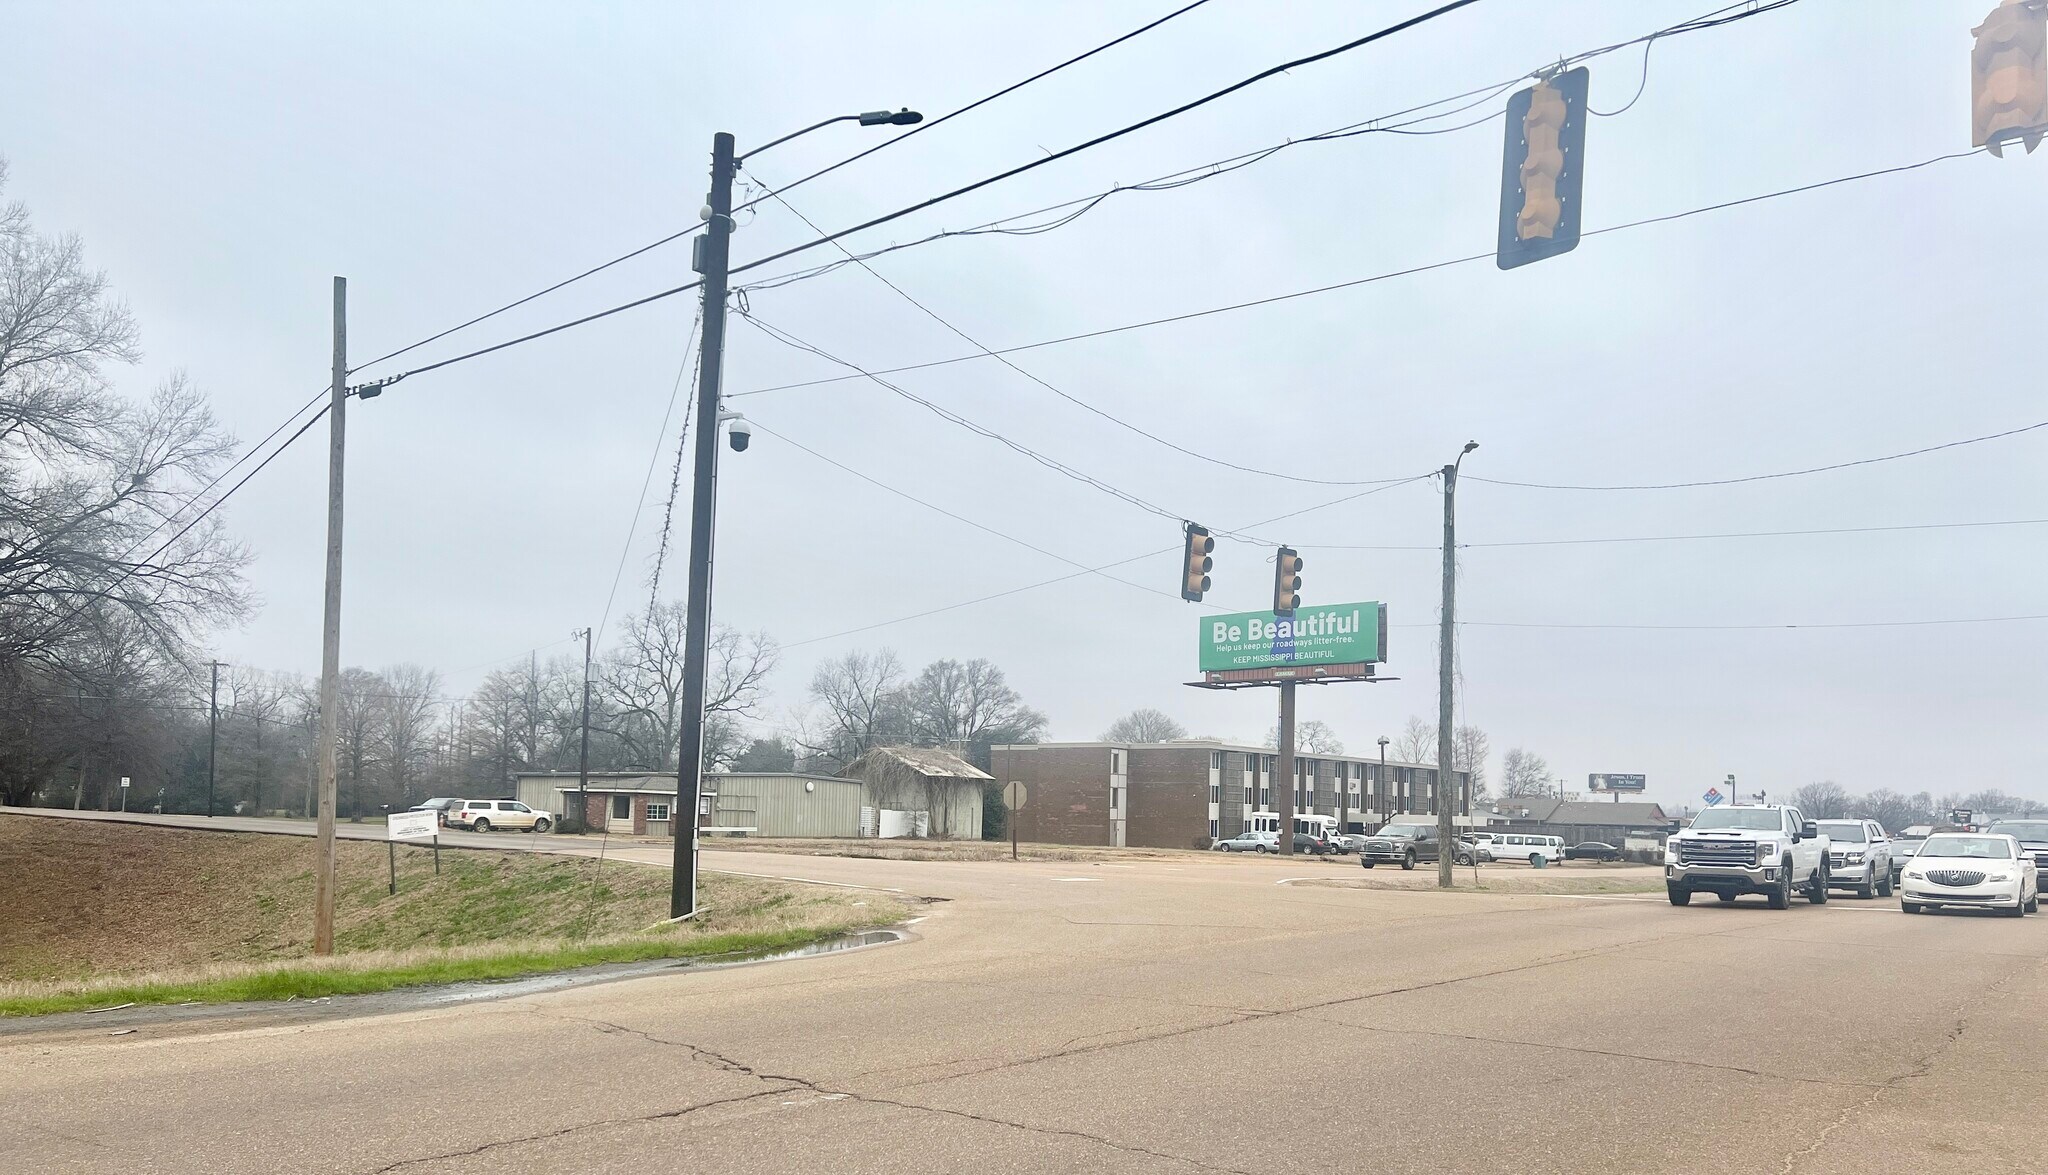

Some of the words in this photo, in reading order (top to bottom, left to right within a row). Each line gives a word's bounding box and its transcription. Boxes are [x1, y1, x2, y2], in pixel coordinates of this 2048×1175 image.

[1213, 622, 1241, 643] Be
[1248, 610, 1359, 640] Beautiful
[1216, 644, 1232, 653] Help
[1243, 643, 1261, 651] keep
[1262, 641, 1274, 649] our
[1276, 639, 1313, 648] roadways
[1314, 636, 1355, 645] litter-free.
[1233, 655, 1252, 664] KEEP
[1252, 652, 1293, 663] MISSISSIPPI
[1294, 650, 1335, 660] BEAUTIFUL
